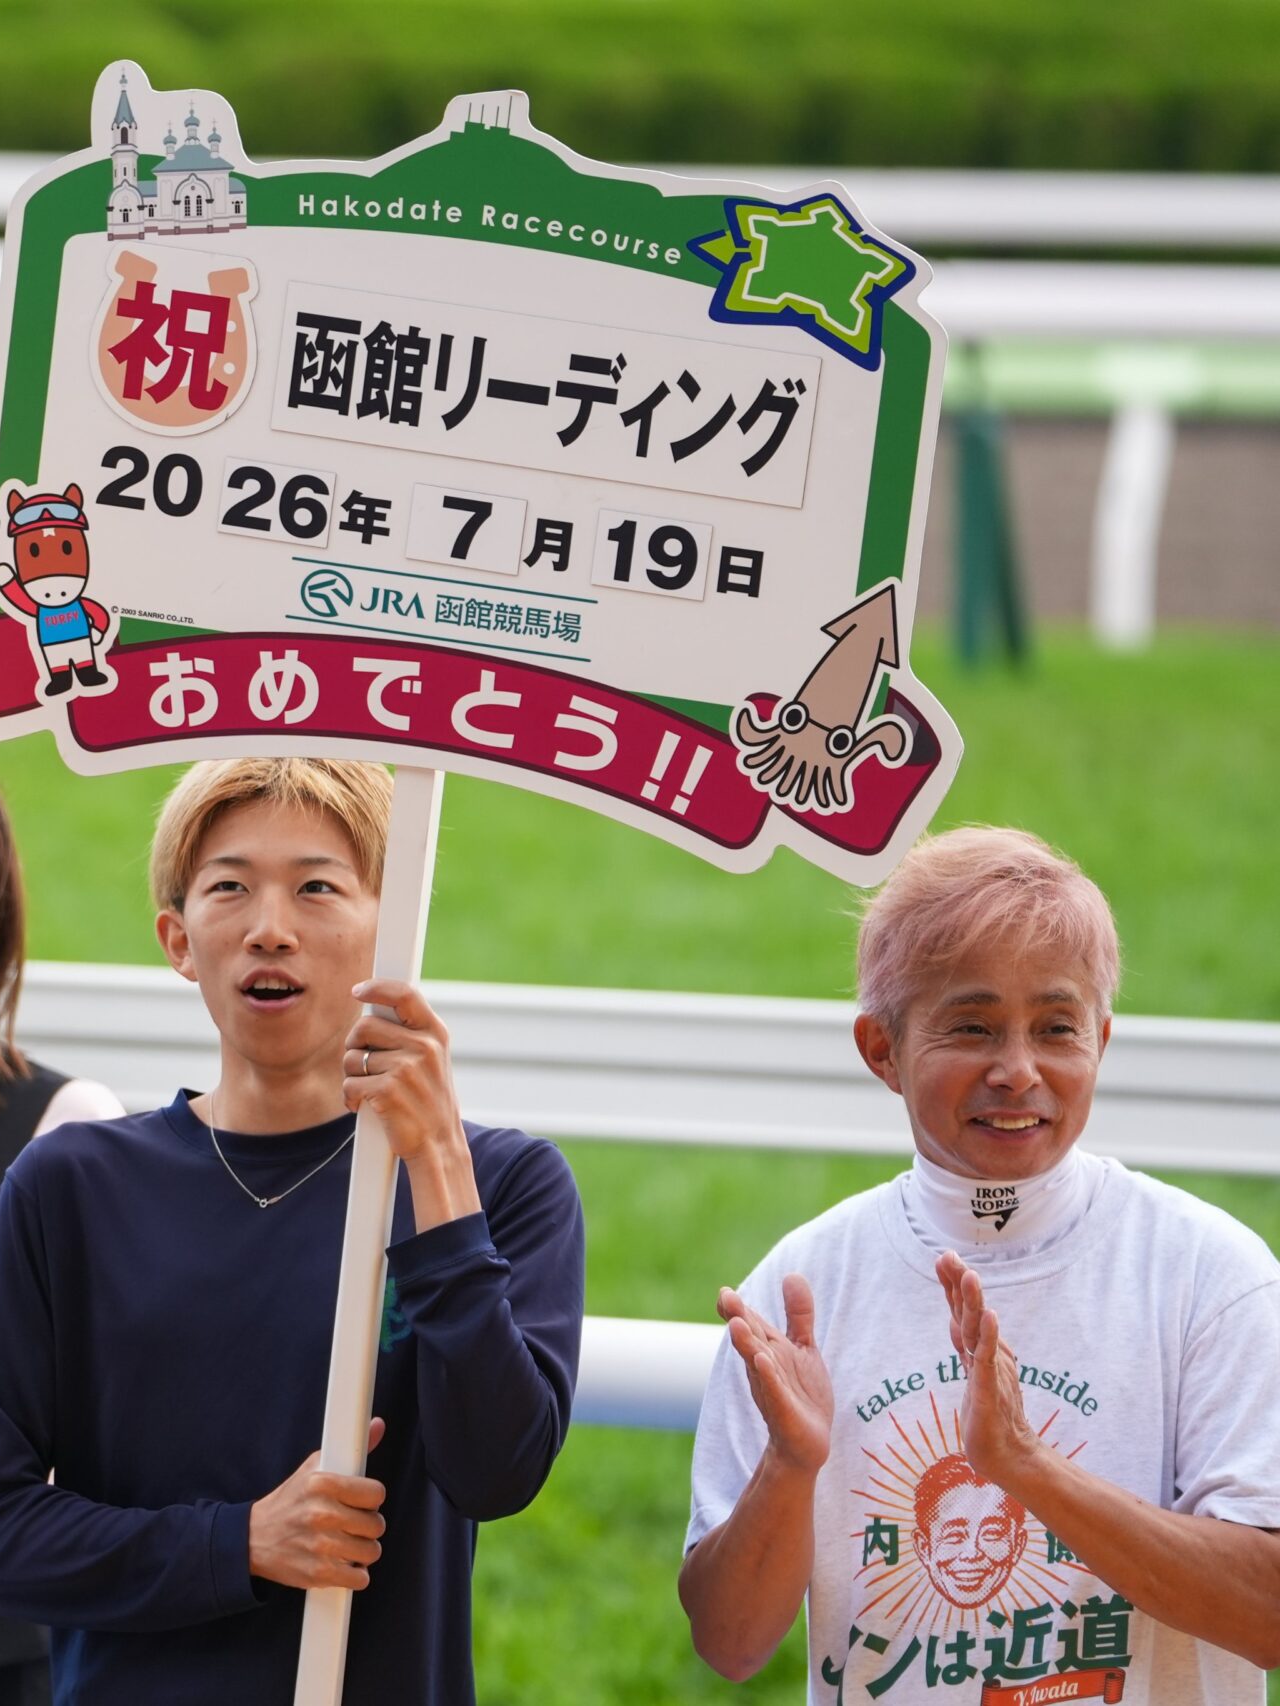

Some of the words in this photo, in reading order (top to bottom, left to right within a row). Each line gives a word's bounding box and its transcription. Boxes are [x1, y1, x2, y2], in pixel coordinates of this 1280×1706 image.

[298, 194, 462, 223] Hakodate
[481, 204, 681, 265] Racecourse
[107, 280, 231, 411] 祝
[287, 311, 808, 478] 函館リーディング
[121, 608, 137, 616] 2003
[138, 610, 165, 620] SANRIO
[360, 586, 426, 620] JRA
[434, 594, 582, 644] 函館競馬場
[970, 1197, 1020, 1212] HORSE
[976, 1186, 1016, 1199] IRON
[856, 1371, 925, 1423] take
[936, 1354, 968, 1384] th
[1014, 1356, 1099, 1417] nside
[862, 1517, 899, 1566] 内
